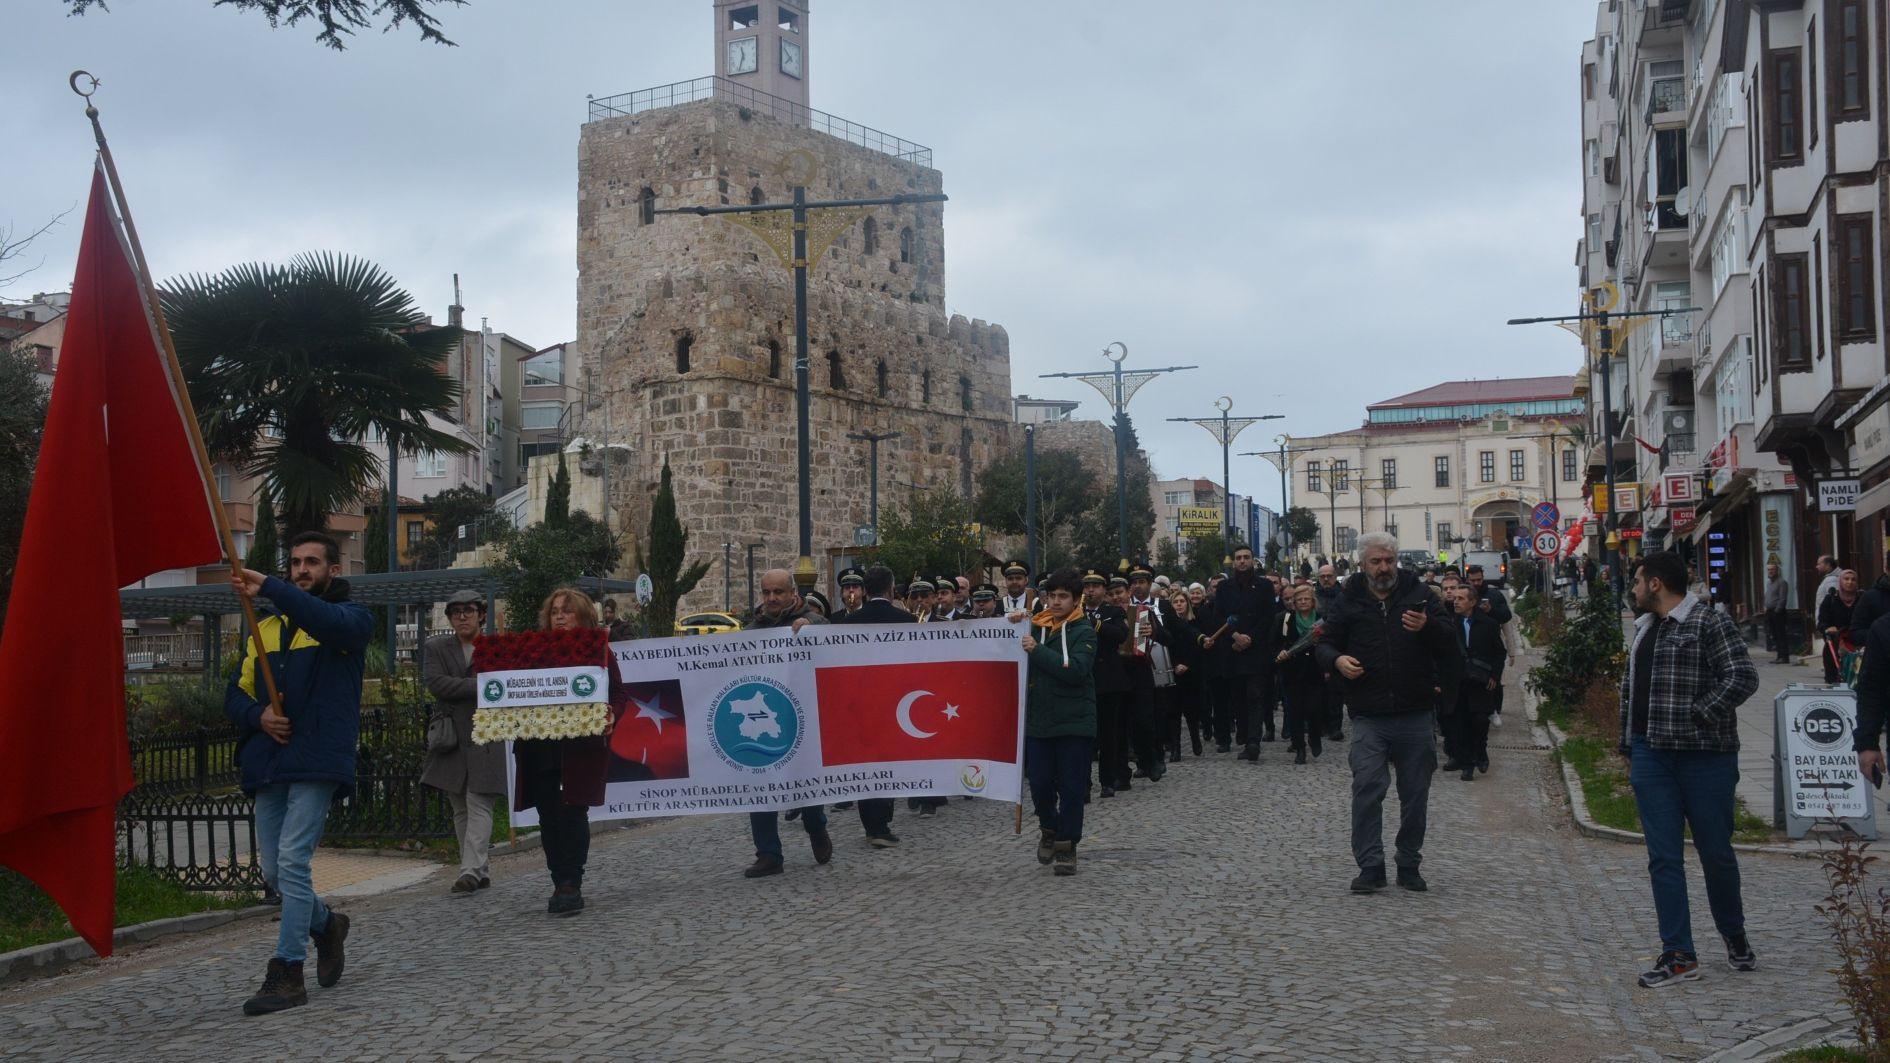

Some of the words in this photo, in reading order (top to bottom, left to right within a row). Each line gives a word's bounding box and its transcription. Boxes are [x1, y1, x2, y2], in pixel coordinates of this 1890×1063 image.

[1672, 480, 1686, 496] E
[1822, 485, 1858, 494] NAMLI
[1539, 537, 1556, 550] 30
[1766, 510, 1781, 565] ECZA
[622, 643, 710, 661] KAYBEDİLMİŞ
[712, 639, 756, 654] VATAN
[760, 632, 870, 650] TOPRAKLARININ
[874, 631, 906, 643] AZİZ
[908, 628, 1018, 641] HATIRALARIDIR.
[677, 658, 728, 672] M.Kemal
[731, 652, 784, 667] ATATÜRK
[788, 651, 812, 662] 1931
[1806, 719, 1842, 732] DES
[1795, 756, 1815, 766] BAY
[1820, 756, 1856, 766] BAYAN
[1832, 770, 1858, 780] TAKI
[640, 786, 678, 799] SİNOP
[680, 784, 750, 798] MÜBADELE
[754, 784, 765, 792] ve
[768, 776, 820, 792] BALKAN
[824, 770, 894, 784] HALKLARI
[609, 801, 660, 813] KÜLTÜR
[664, 797, 768, 810] ARAŞTIRMALARI
[770, 794, 790, 804] VE
[793, 784, 870, 800] DAYANIŞMA
[874, 778, 934, 792] DERNEĞİ
